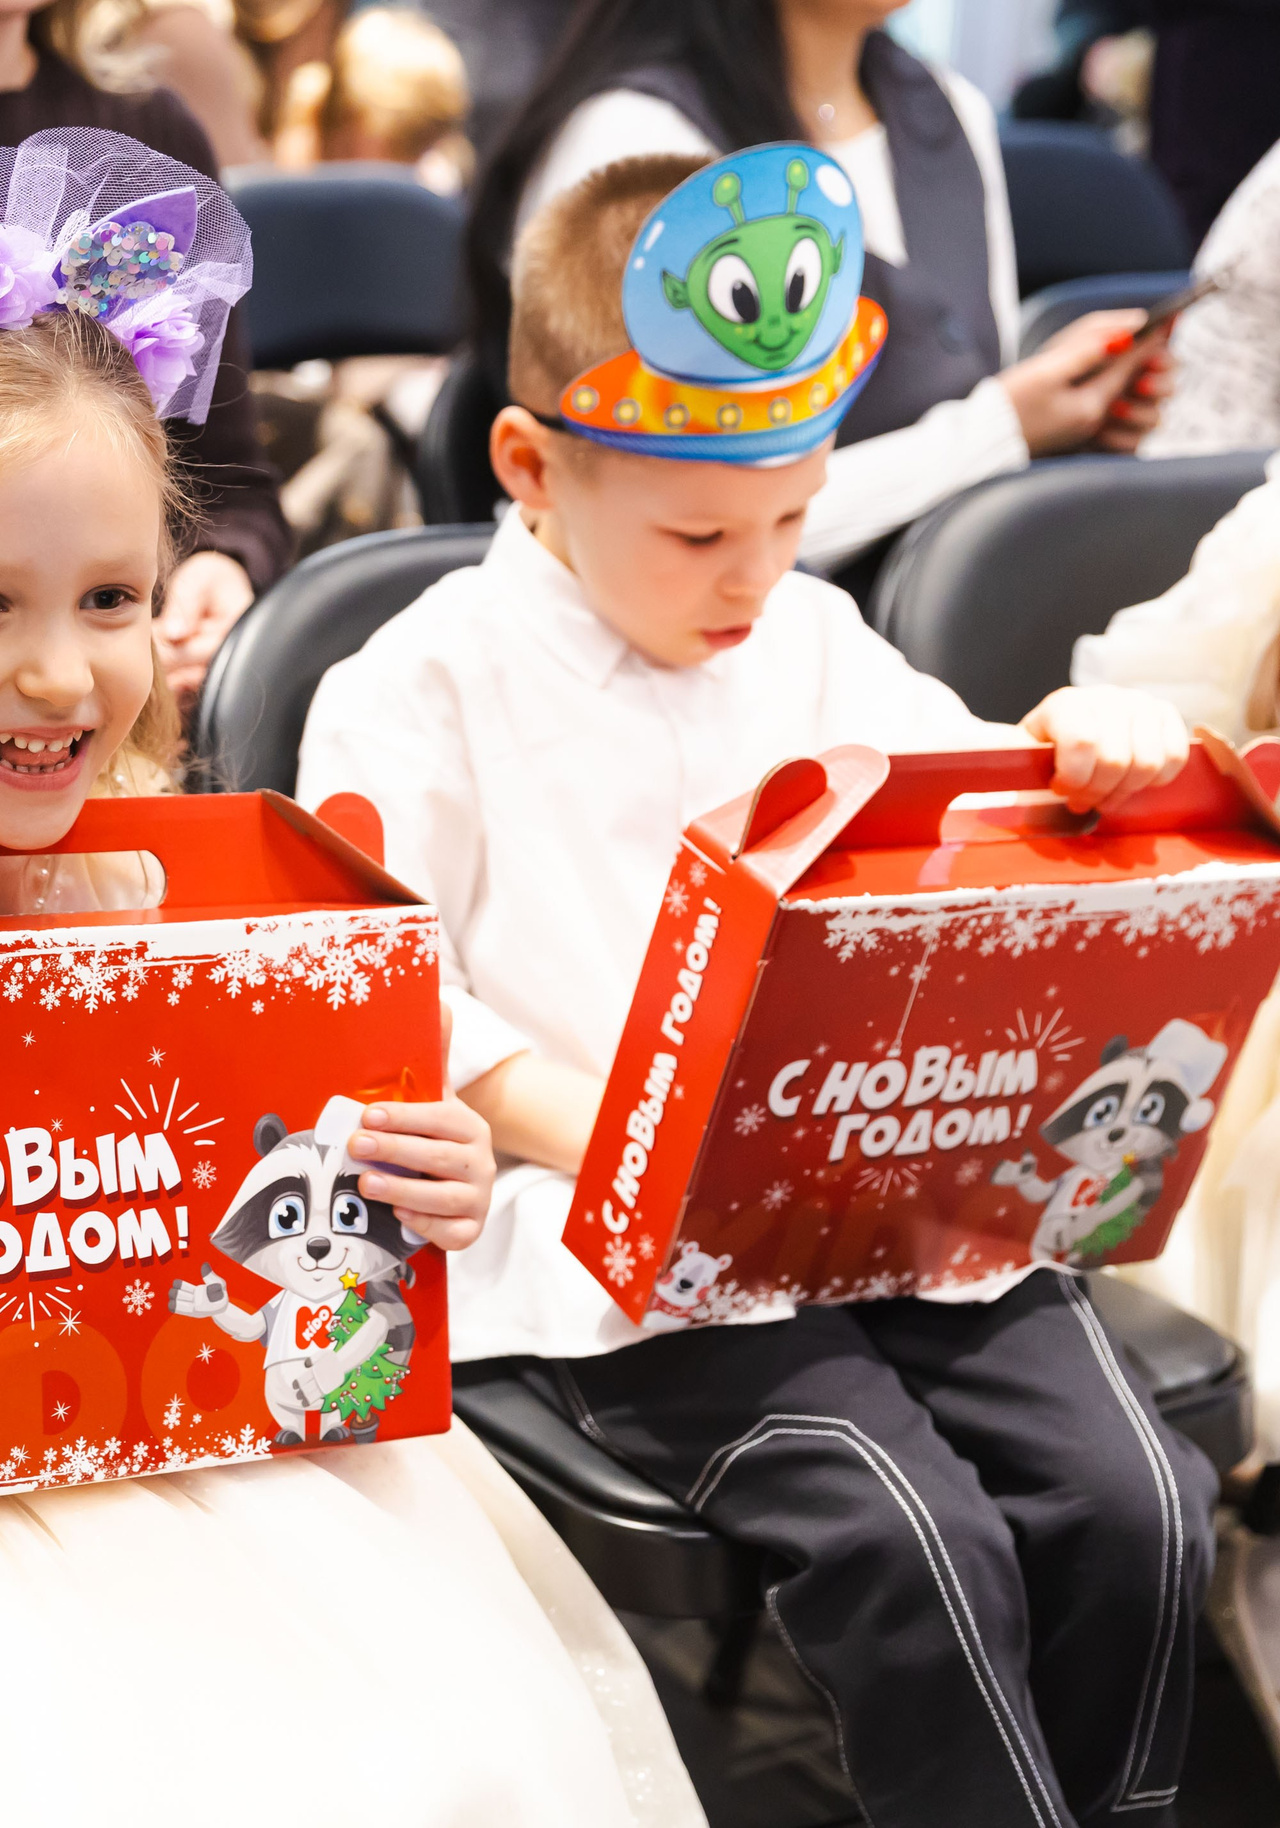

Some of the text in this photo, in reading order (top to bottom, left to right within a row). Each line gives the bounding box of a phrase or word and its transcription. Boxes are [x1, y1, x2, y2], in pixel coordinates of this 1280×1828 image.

[602, 897, 722, 1234] С НОВЫМ ГОДОМ!
[768, 1045, 1039, 1118] С НОВЫМ
[827, 1103, 1033, 1163] ГОДОМ!
